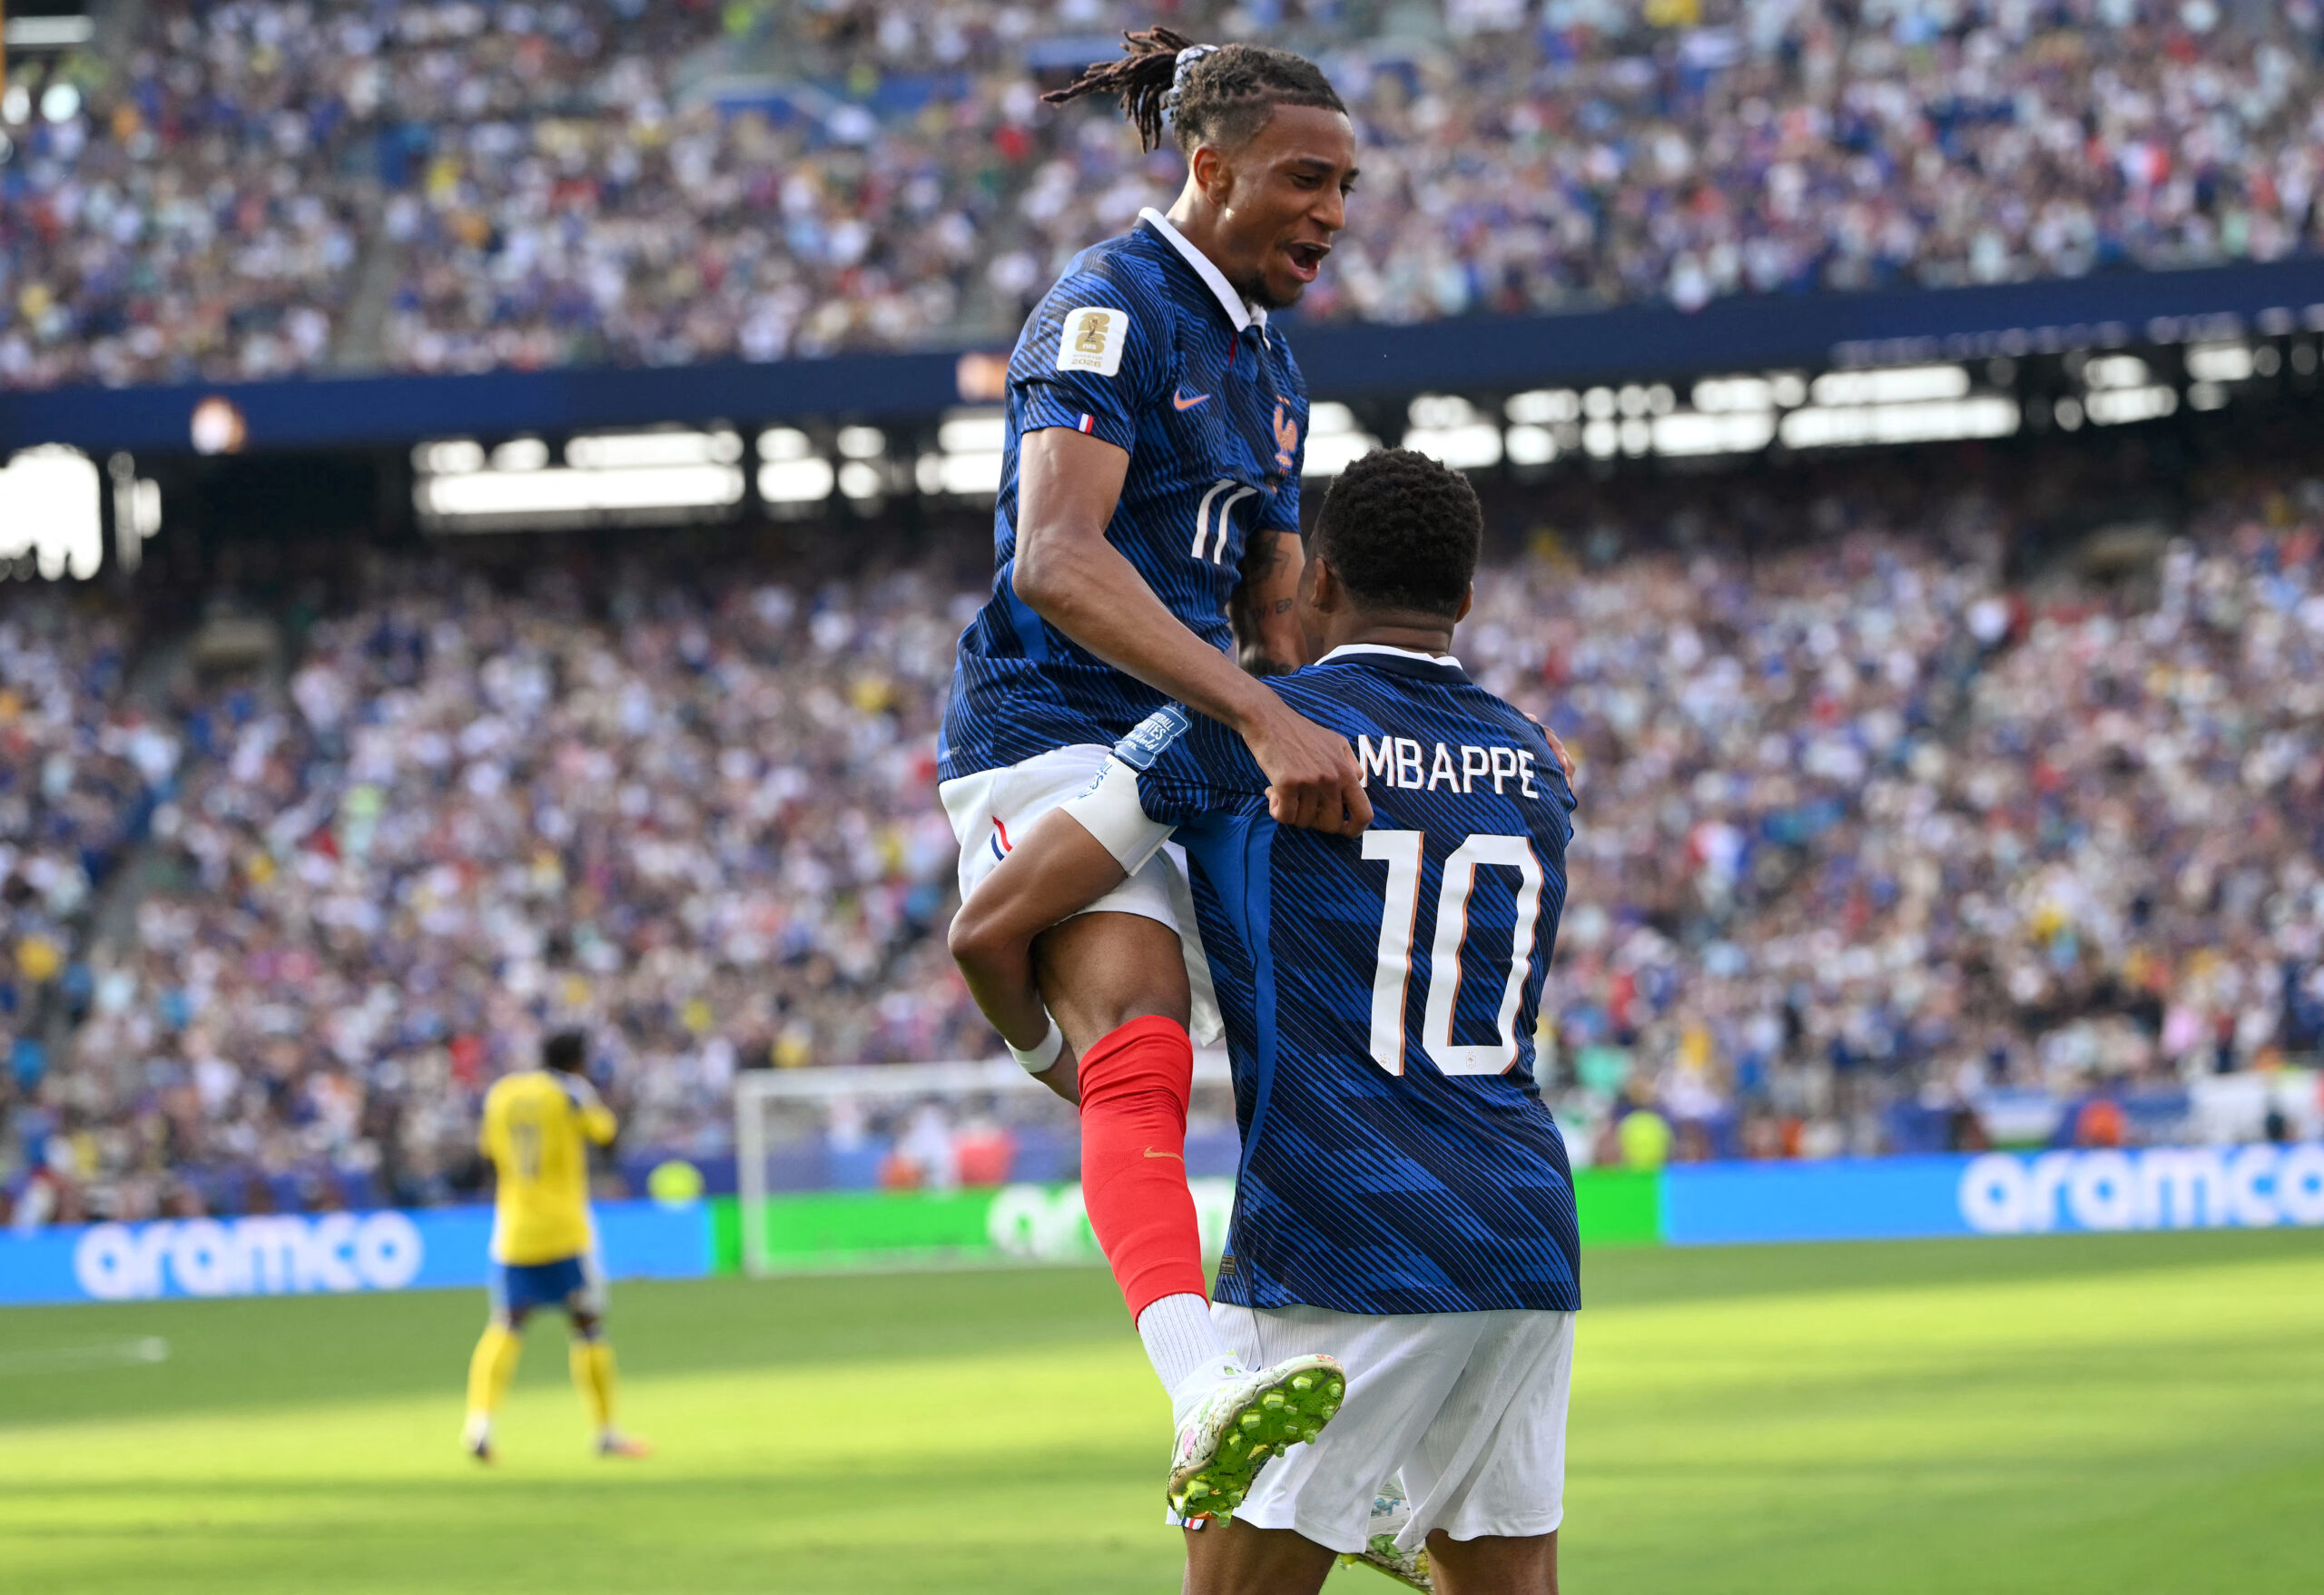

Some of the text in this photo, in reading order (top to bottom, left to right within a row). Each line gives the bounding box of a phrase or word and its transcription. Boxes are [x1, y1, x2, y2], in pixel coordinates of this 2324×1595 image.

[1191, 478, 1258, 565] 11
[1357, 734, 1540, 800] MBAPPE
[1361, 830, 1544, 1077] 10
[74, 1211, 424, 1300] aramco
